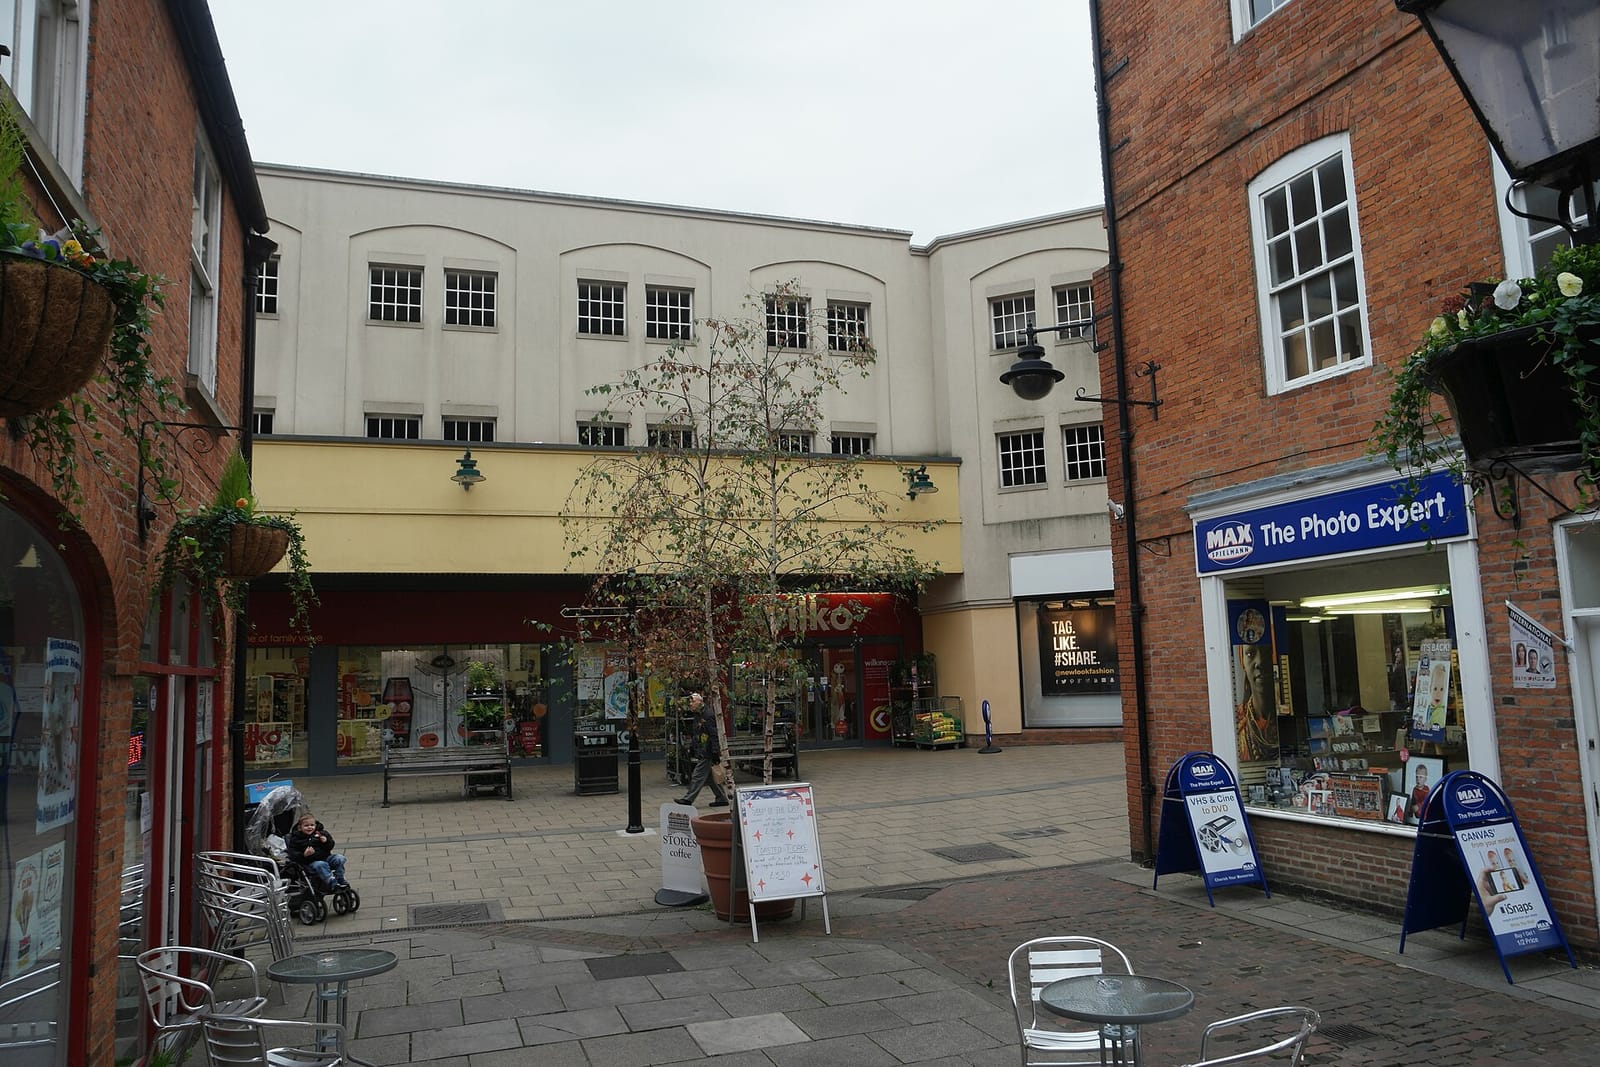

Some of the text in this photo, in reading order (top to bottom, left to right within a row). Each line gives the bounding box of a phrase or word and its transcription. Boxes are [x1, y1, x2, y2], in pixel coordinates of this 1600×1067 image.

[1260, 491, 1447, 547] The Photo Expert
[1206, 523, 1252, 550] MAX
[1211, 547, 1250, 559] SPIELMANN
[1052, 620, 1076, 635] TAG.
[1509, 610, 1552, 646] INTERNATIONAL
[257, 634, 269, 643] of
[269, 632, 297, 645] family
[1053, 636, 1080, 651] LIKE.
[1421, 643, 1451, 653] IT'S BACK!
[1055, 651, 1101, 666] #SHARE.
[1055, 667, 1115, 677] @newlookfashion
[1192, 765, 1214, 774] MAX
[1198, 780, 1210, 788] Photo
[1210, 780, 1225, 788] Expert
[1190, 794, 1236, 806] VHS & Cine
[1457, 788, 1484, 802] MAX
[1202, 804, 1229, 816] to DVD
[1457, 808, 1498, 820] The Photo Expert
[663, 835, 698, 848] STOKES
[1471, 836, 1516, 849] from your mobile
[669, 847, 692, 859] coffee
[1504, 901, 1534, 915] iSnaps
[1516, 937, 1540, 947] 1/2 Price
